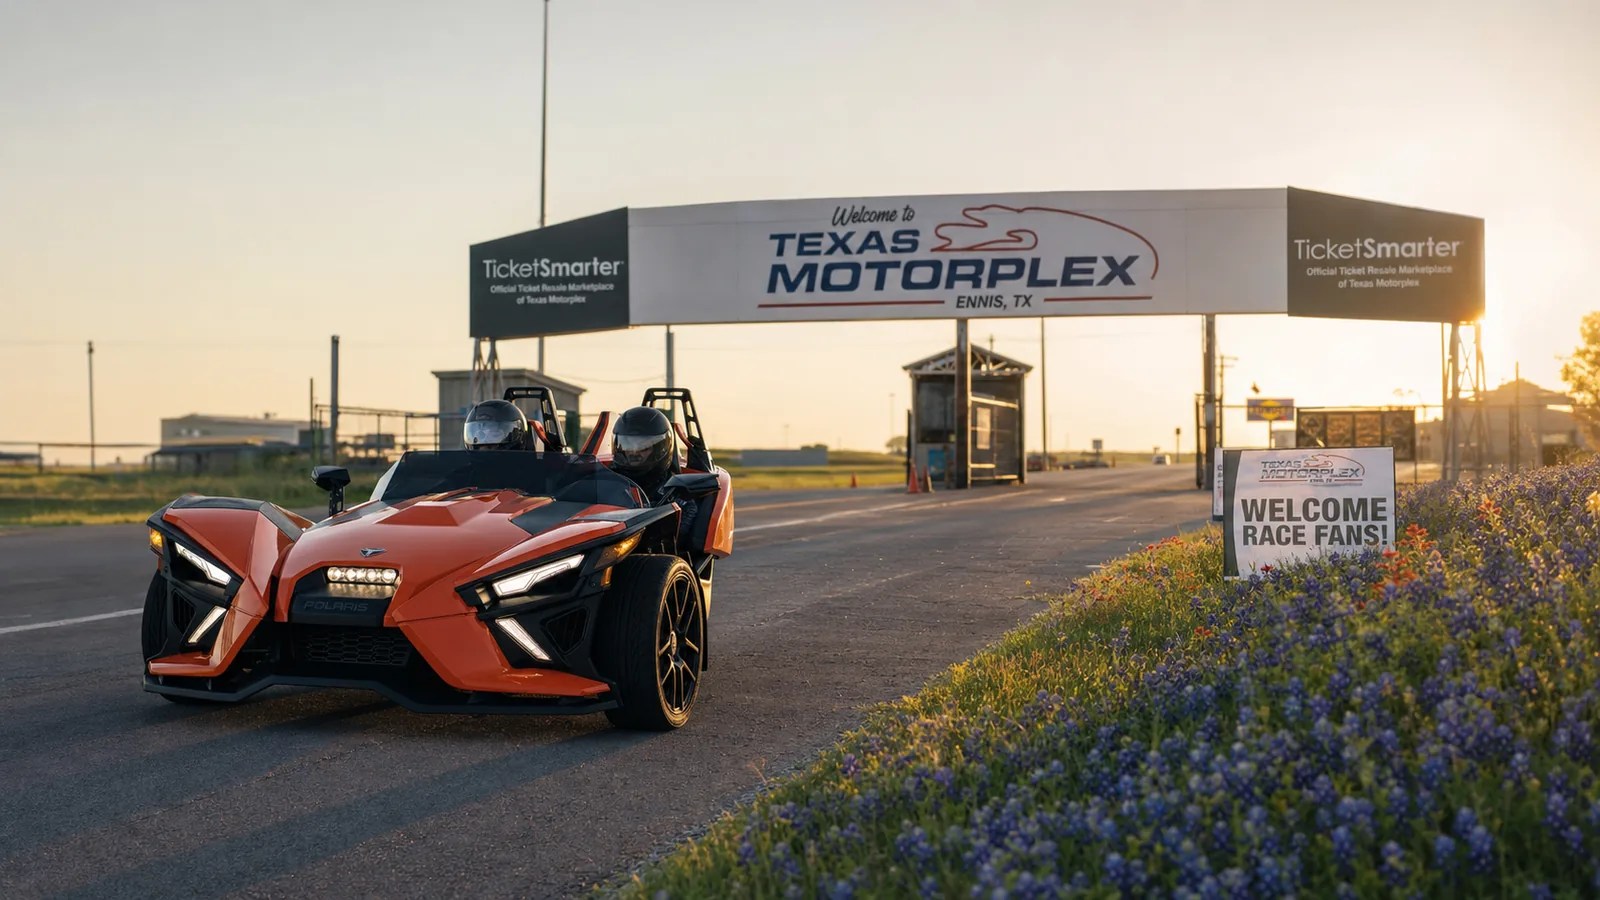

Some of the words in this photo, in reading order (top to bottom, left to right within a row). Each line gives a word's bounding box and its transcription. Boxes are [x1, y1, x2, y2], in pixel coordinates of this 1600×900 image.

[832, 204, 898, 226] Welcome
[902, 204, 916, 221] to
[769, 229, 920, 257] TEXAS
[1294, 237, 1461, 260] TicketSmarter
[482, 257, 620, 278] TicketSmarter
[767, 255, 1140, 294] MOTORPLEX
[1306, 266, 1337, 276] Official
[1340, 266, 1366, 275] Ticket
[1367, 265, 1396, 275] Resale
[1399, 264, 1453, 276] Marketplace
[490, 284, 517, 293] Official
[518, 284, 541, 292] Ticket
[568, 282, 614, 292] Marketplace
[1338, 279, 1347, 288] of
[1349, 279, 1374, 288] Texas
[1375, 278, 1420, 289] Motorplex
[516, 296, 525, 304] of
[526, 296, 547, 304] Texas
[548, 295, 586, 304] Motorplex
[956, 295, 1007, 310] ENNIS,
[1013, 294, 1033, 307] TX
[1261, 460, 1301, 469] TEXAS
[1260, 468, 1360, 479] MOTORPLEX
[1241, 497, 1387, 522] WELCOME
[1242, 524, 1306, 546] RACE
[1314, 524, 1388, 546] FANS!
[304, 601, 369, 612] POLARIS
